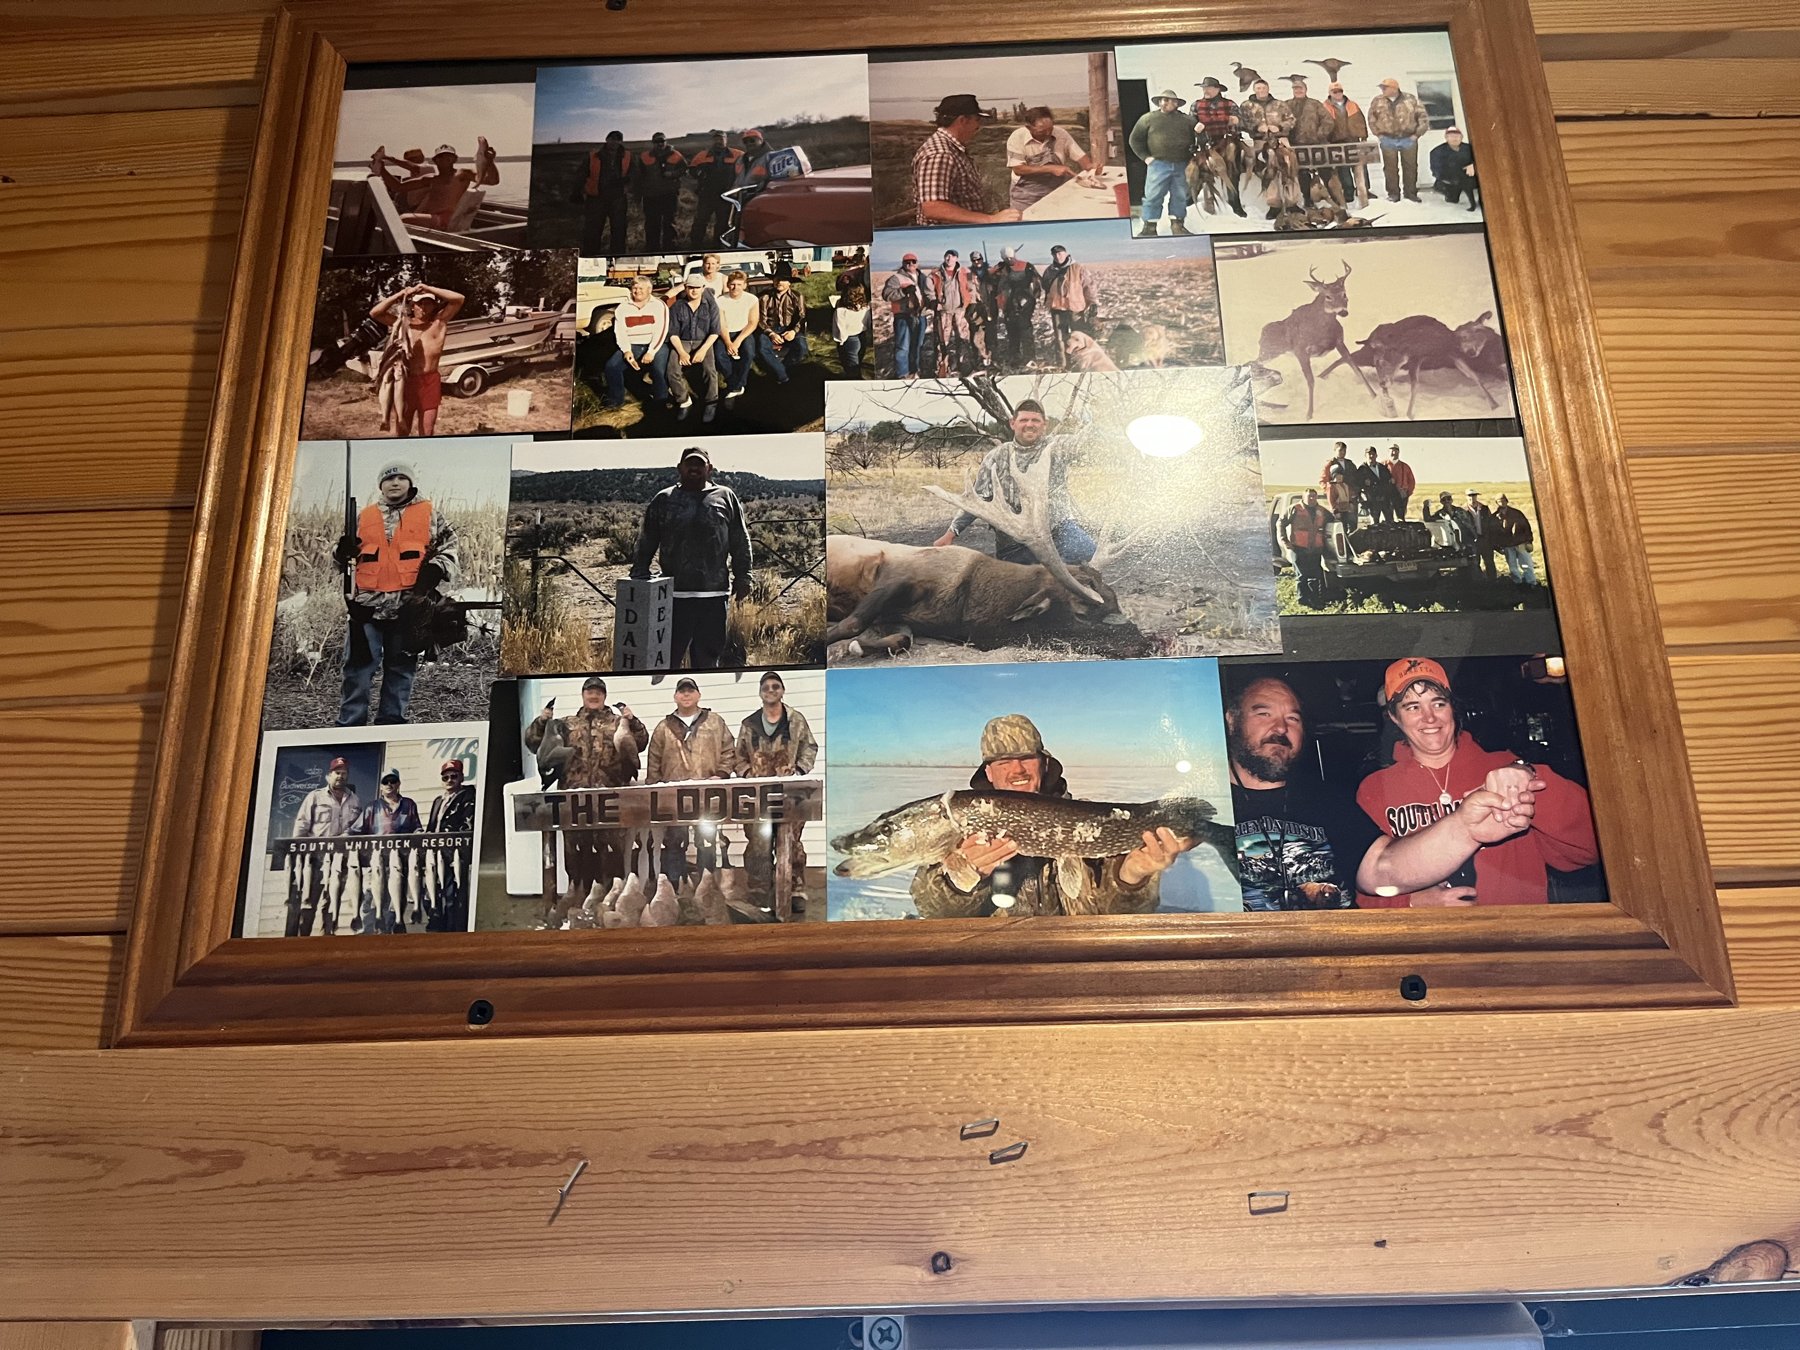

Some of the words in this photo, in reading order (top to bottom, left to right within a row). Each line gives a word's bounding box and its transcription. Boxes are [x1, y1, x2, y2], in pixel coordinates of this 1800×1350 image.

[1295, 145, 1360, 166] ODGE
[655, 584, 668, 667] NEVA
[1398, 666, 1434, 679] BETTA
[544, 793, 620, 827] THE
[650, 784, 784, 823] LODGE
[1385, 802, 1441, 838] SOUTH
[289, 842, 335, 853] SOUTH
[345, 839, 411, 850] WHITLOCK
[422, 837, 472, 848] RESORT
